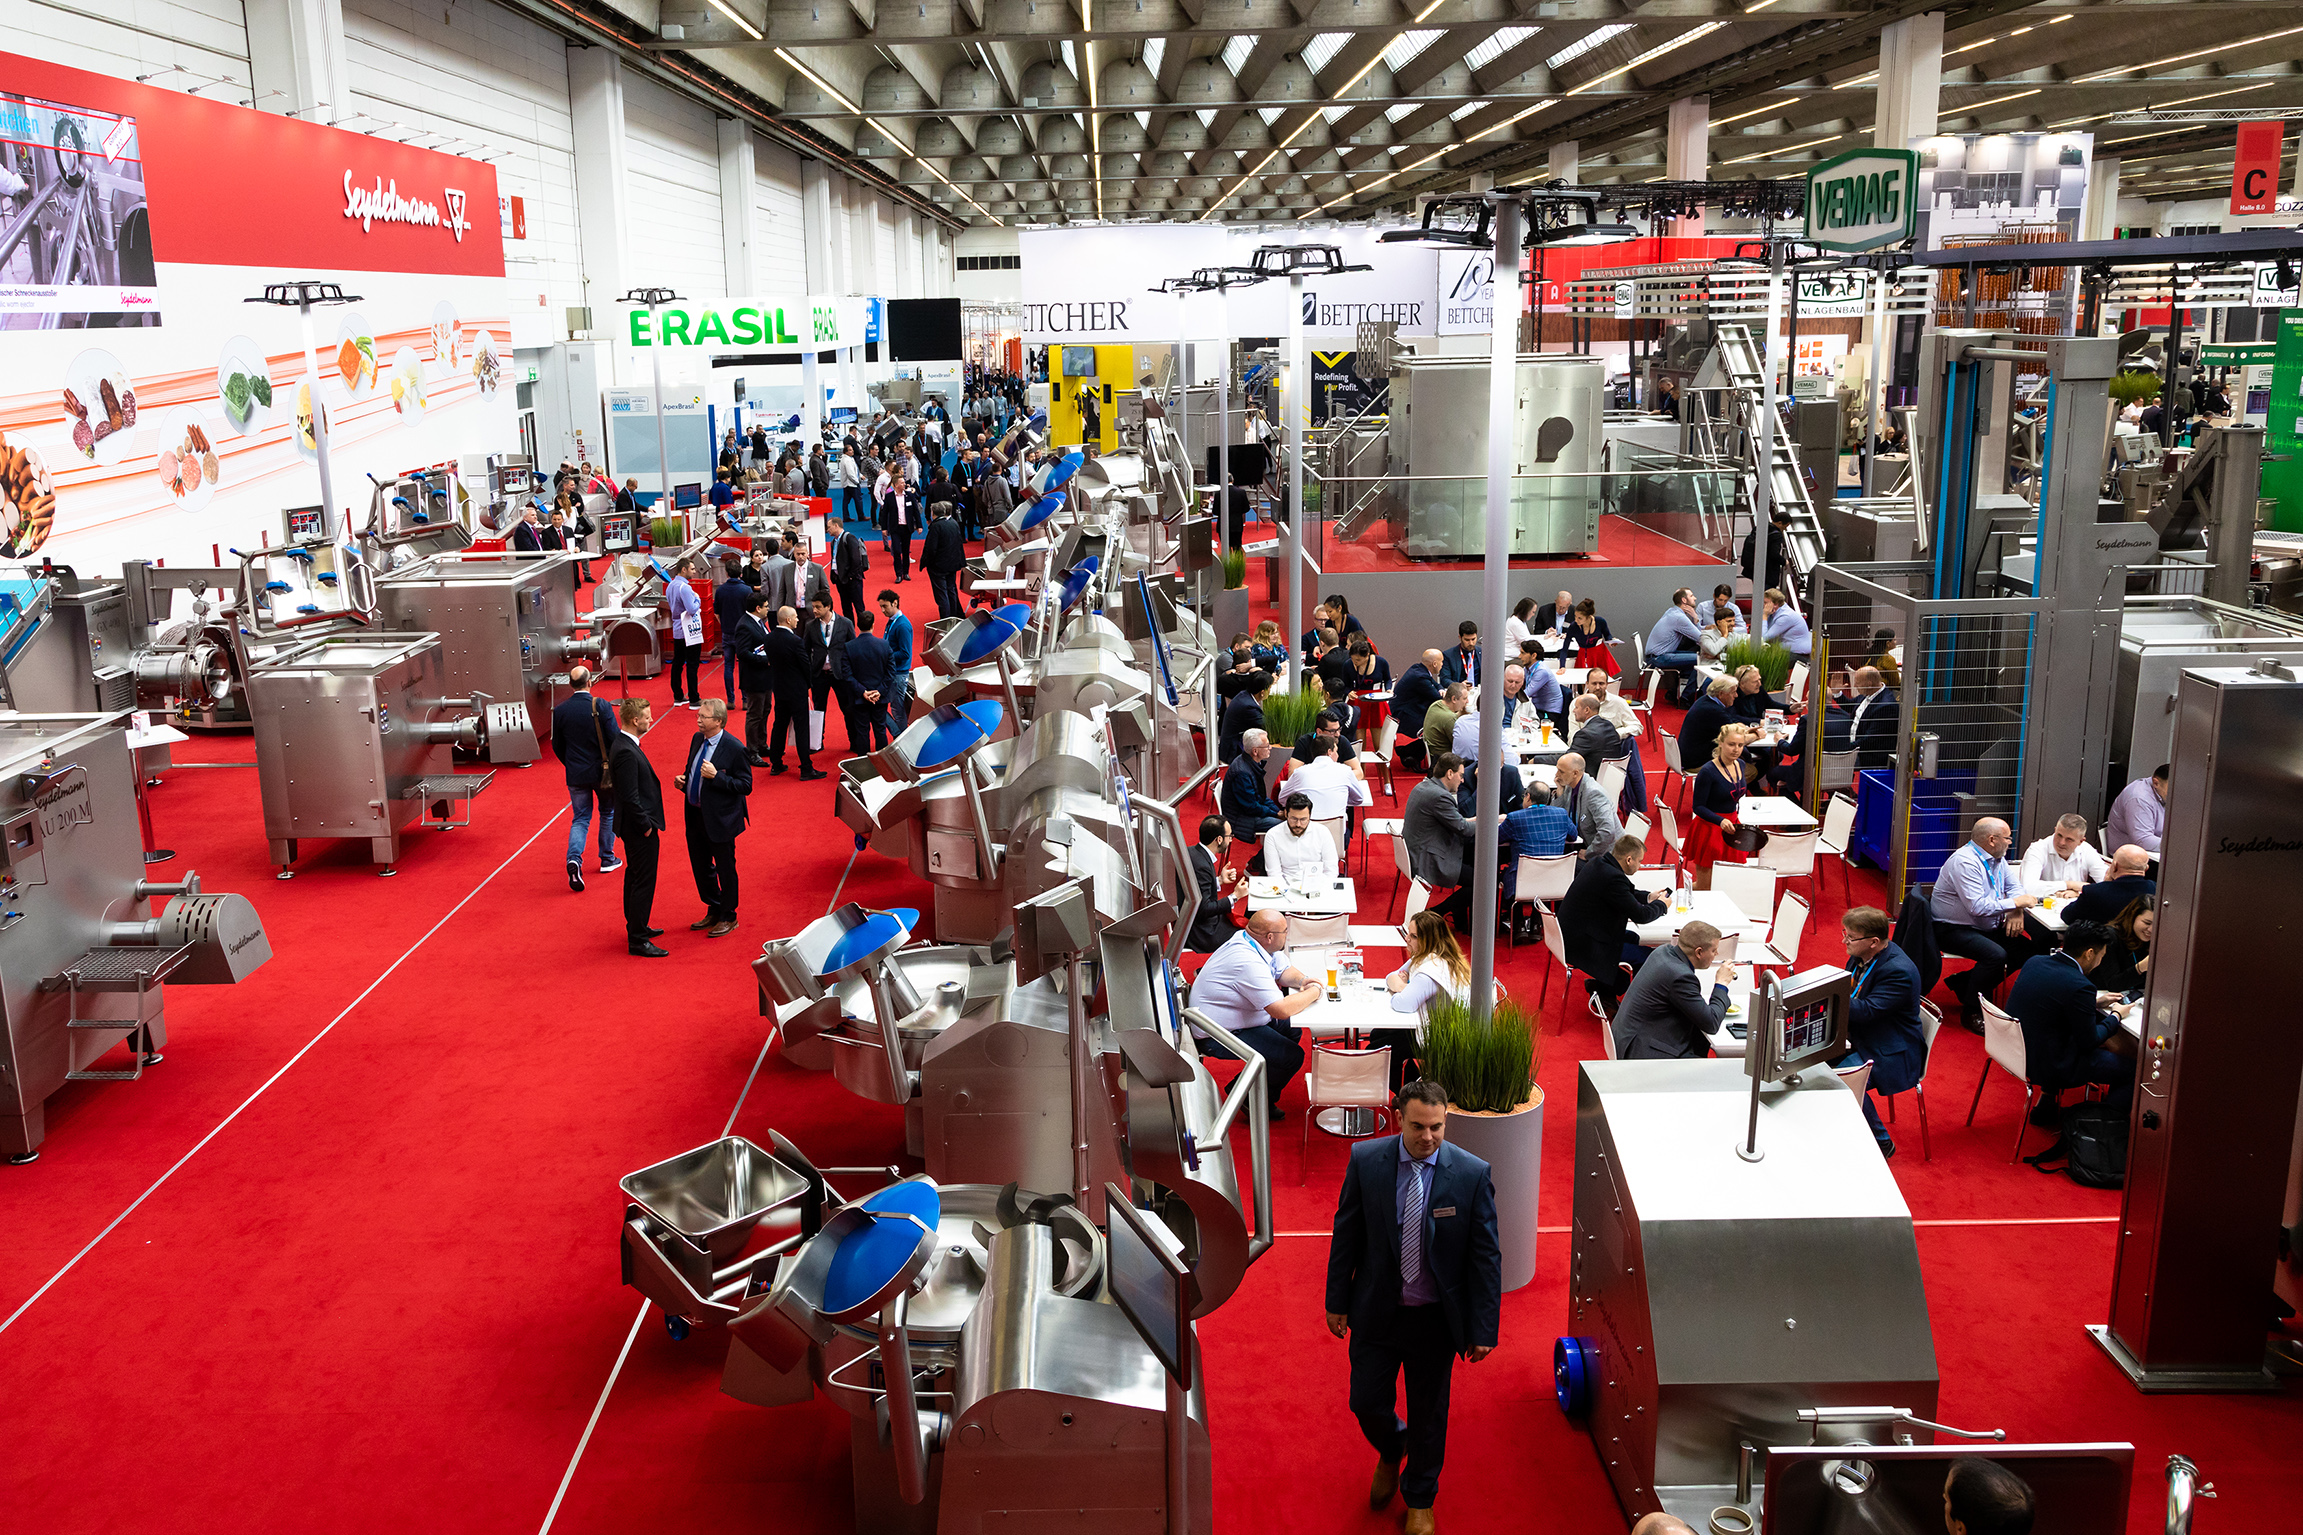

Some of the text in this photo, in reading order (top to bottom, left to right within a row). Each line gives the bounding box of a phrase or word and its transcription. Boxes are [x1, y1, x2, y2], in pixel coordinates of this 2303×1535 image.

[2243, 169, 2267, 200] C
[343, 169, 440, 233] Seydelmann
[1814, 169, 1900, 231] VEMAG
[120, 292, 153, 307] Seydelmann
[630, 307, 799, 347] BRASIL
[813, 306, 839, 343] BRASIL
[1314, 372, 1349, 383] Redefining
[1338, 383, 1359, 391] Profit.
[662, 403, 695, 411] ApexBrasil
[2095, 538, 2153, 551] Seydelmann
[34, 780, 86, 812] Seydelmann
[57, 808, 78, 828] 200
[78, 801, 91, 820] M
[228, 928, 261, 956] Seydelmann
